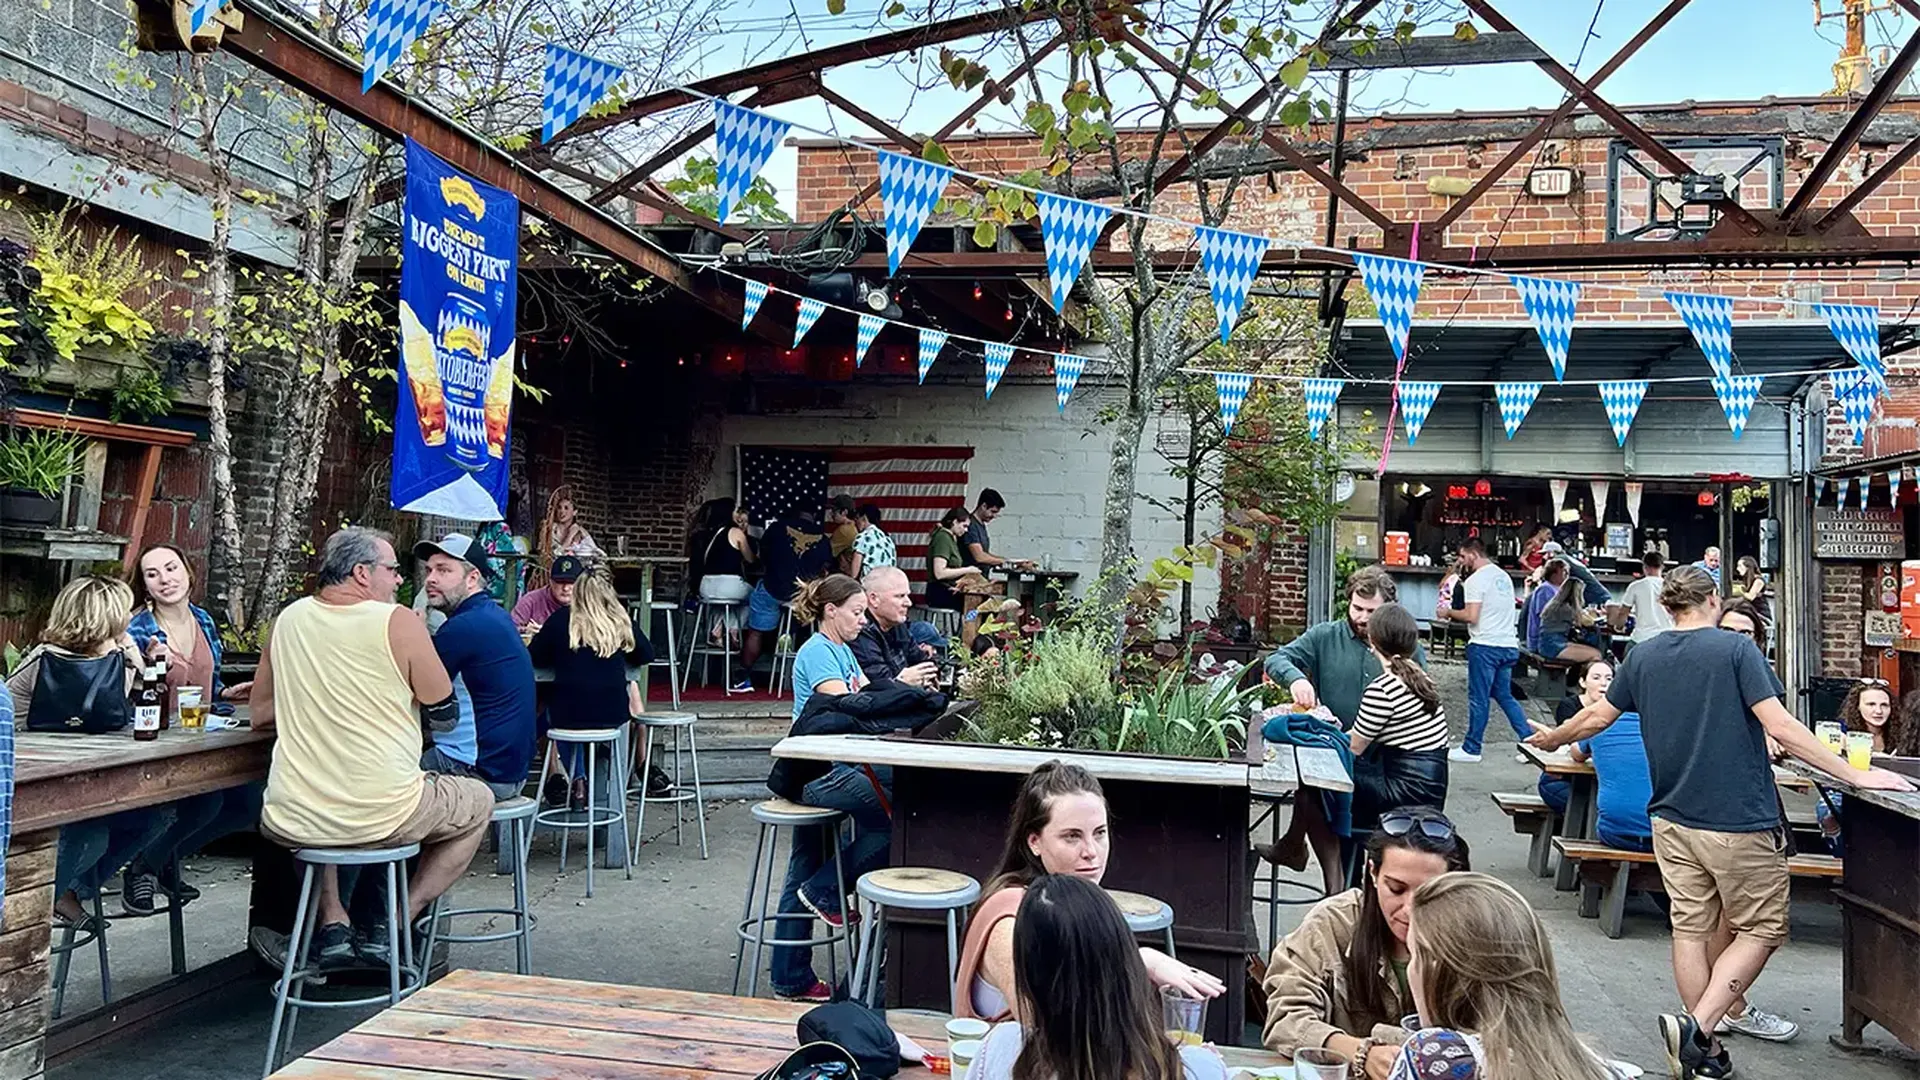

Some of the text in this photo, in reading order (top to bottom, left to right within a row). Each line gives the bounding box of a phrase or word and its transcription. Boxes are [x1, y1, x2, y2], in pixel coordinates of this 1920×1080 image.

[1539, 172, 1565, 192] EXIT
[410, 213, 471, 272] BIGGEST
[443, 217, 479, 249] BREWED
[446, 262, 486, 295] ON EARTH
[1817, 521, 1903, 533] IN OPEN POSITION
[1852, 532, 1890, 543] BUILDI
[1829, 543, 1893, 555] IS OCCUPIED
